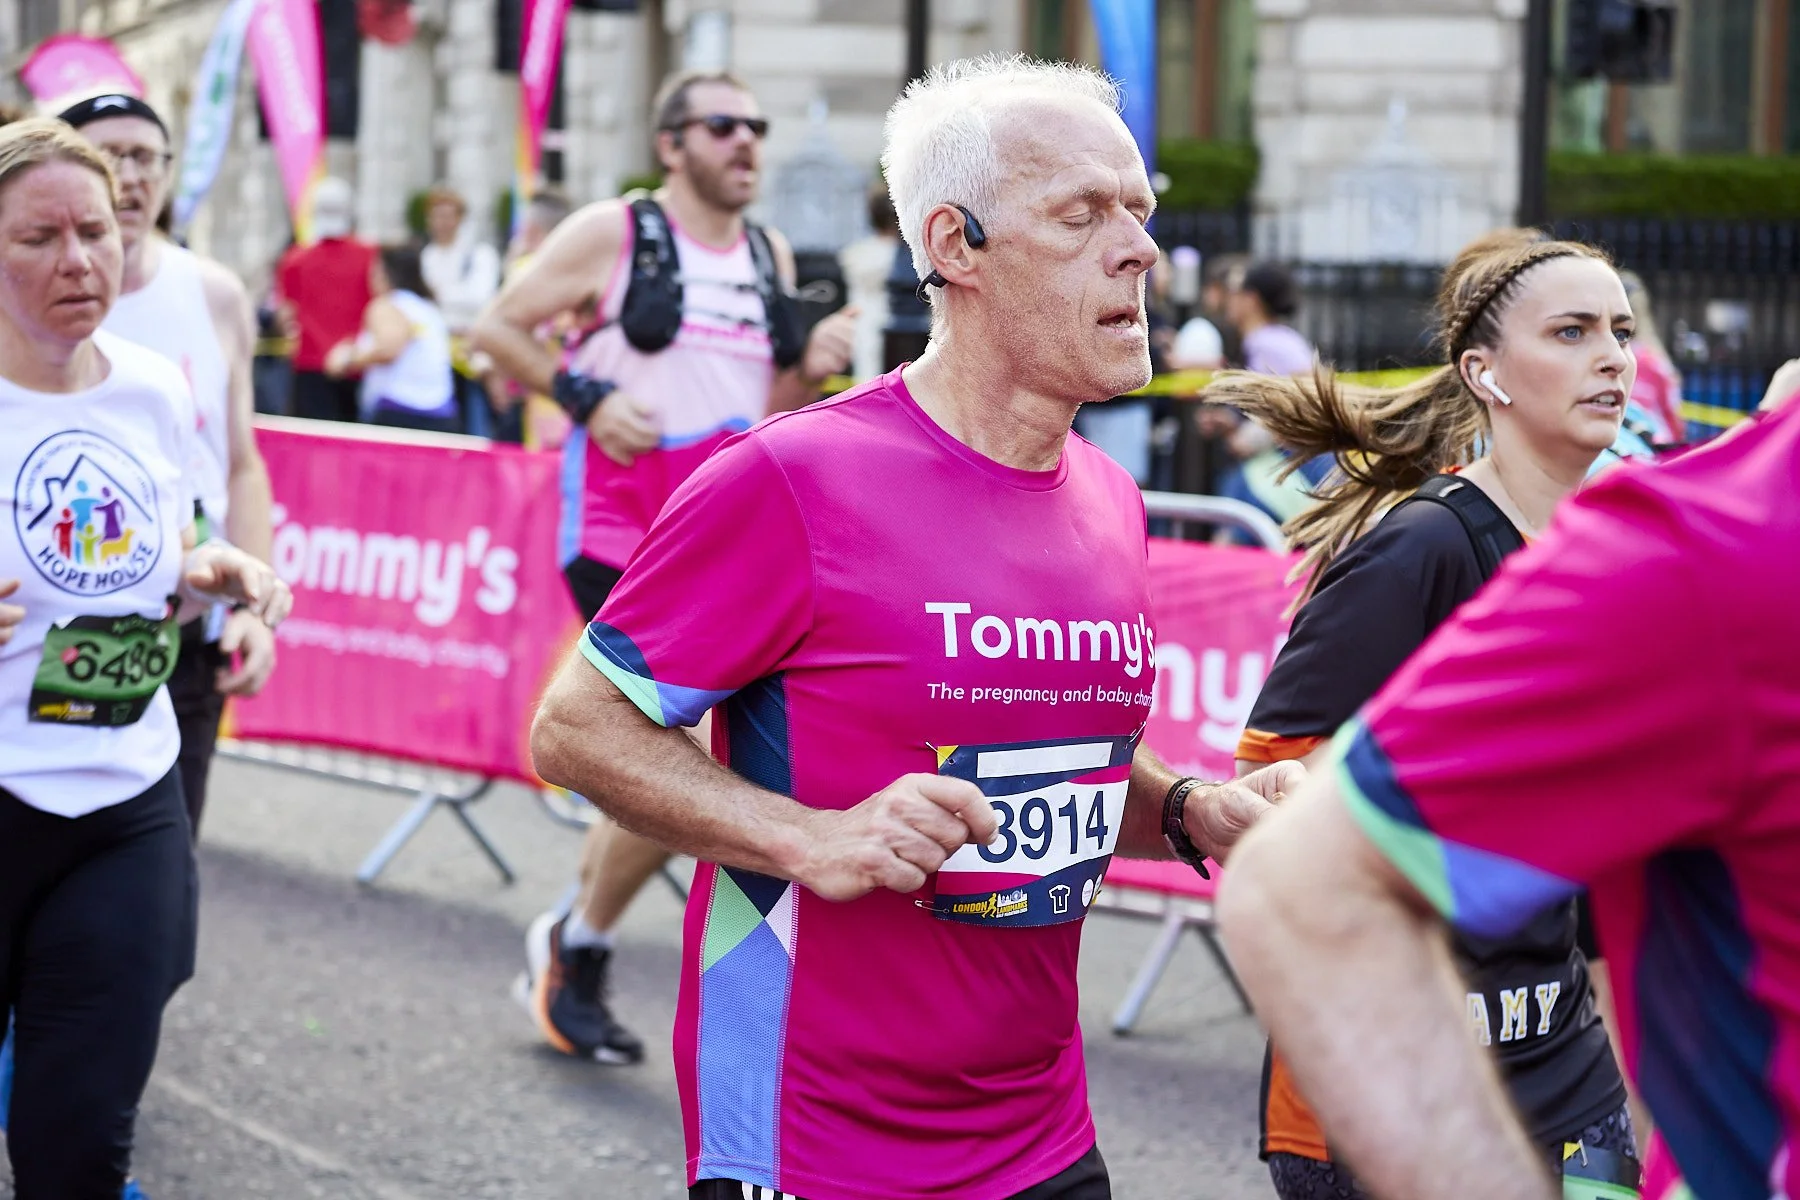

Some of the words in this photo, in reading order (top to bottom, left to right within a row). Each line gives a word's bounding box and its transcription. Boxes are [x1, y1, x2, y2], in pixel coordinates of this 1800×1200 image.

[38, 546, 90, 589] HOPE
[94, 541, 153, 589] HOUSE
[271, 503, 519, 627] ommy's
[925, 602, 1155, 678] Tommy's
[927, 683, 964, 699] The
[971, 687, 1058, 706] pregnancy
[1062, 685, 1092, 702] and
[1096, 686, 1132, 706] baby
[953, 901, 987, 913] LONDON
[1466, 981, 1561, 1046] AMY
